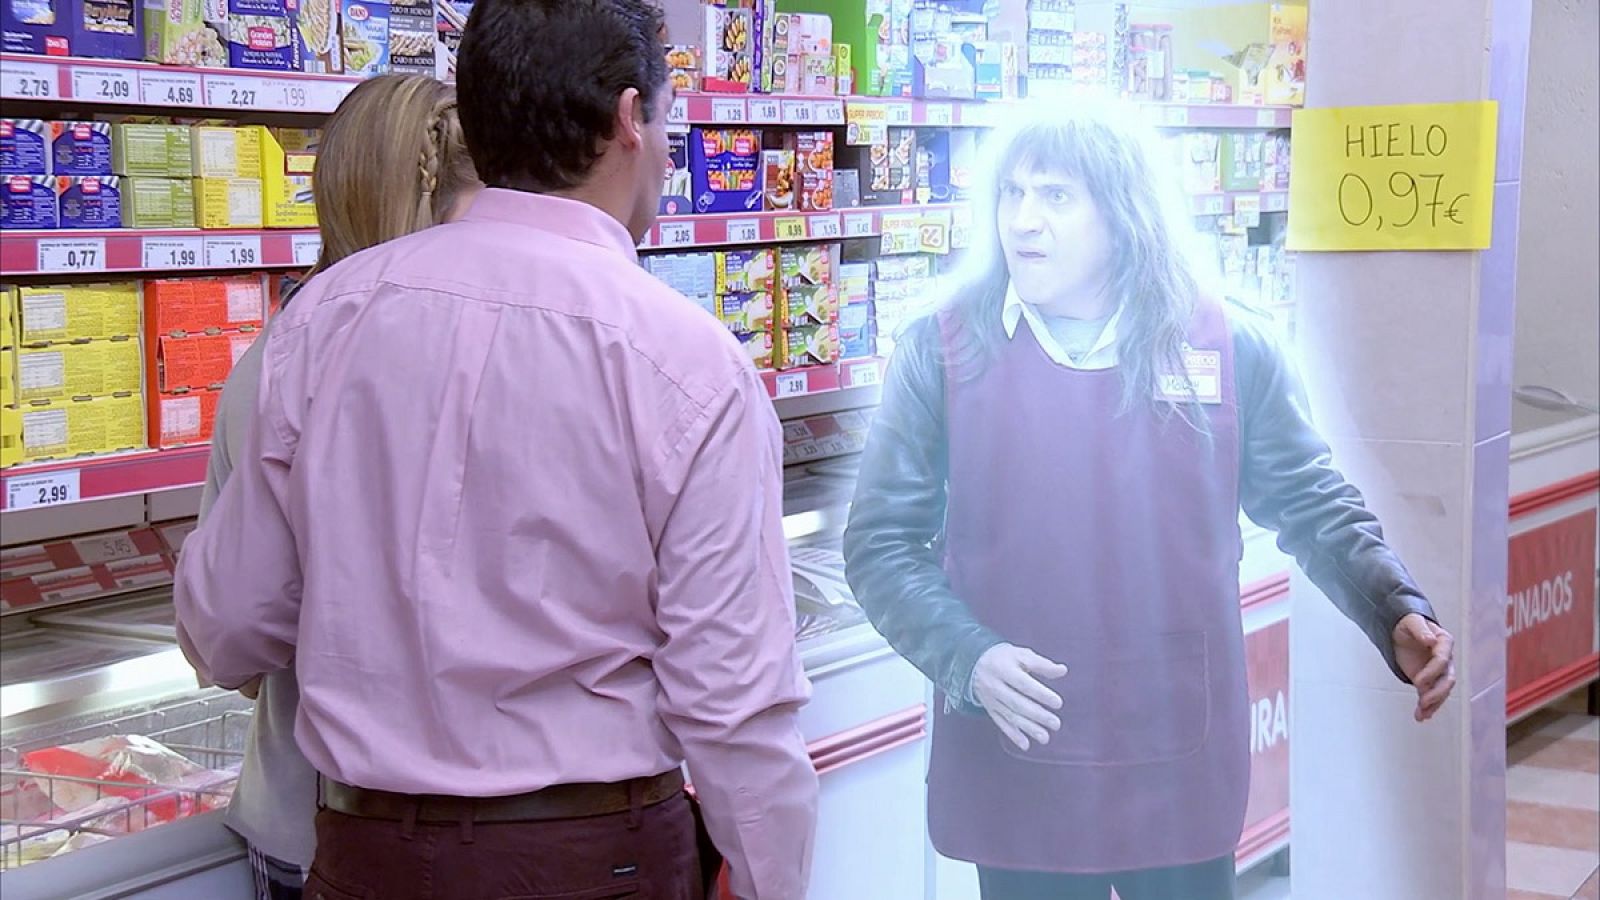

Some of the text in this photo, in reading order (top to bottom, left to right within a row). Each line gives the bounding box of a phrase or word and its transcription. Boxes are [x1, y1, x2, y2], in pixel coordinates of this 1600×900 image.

[19, 78, 50, 97] 2,79
[101, 79, 129, 99] 2,09
[167, 87, 193, 104] 4,69
[231, 89, 256, 107] 2,27
[1345, 123, 1448, 158] HIELO
[1338, 171, 1471, 231] 0,97€
[67, 250, 97, 269] 0,77
[169, 249, 196, 267] 1,99
[230, 247, 255, 265] 1,99
[38, 484, 68, 504] 2,99
[1505, 570, 1573, 638] CINADOS
